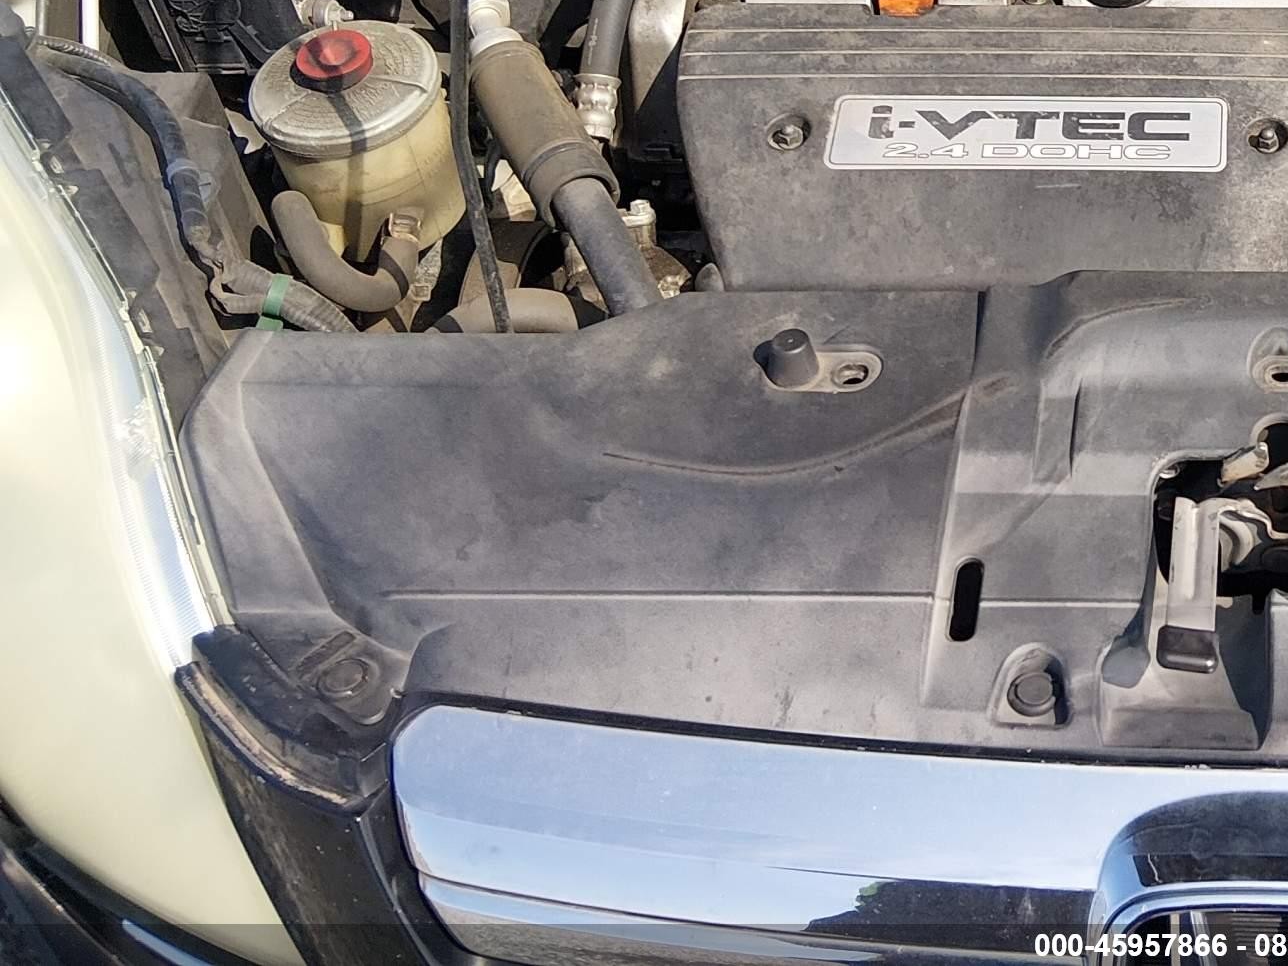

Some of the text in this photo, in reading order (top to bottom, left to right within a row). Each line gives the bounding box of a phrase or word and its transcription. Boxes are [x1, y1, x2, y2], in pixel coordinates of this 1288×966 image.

[867, 105, 1191, 141] i-VTEC
[882, 142, 1171, 160] 2.4 DOHC
